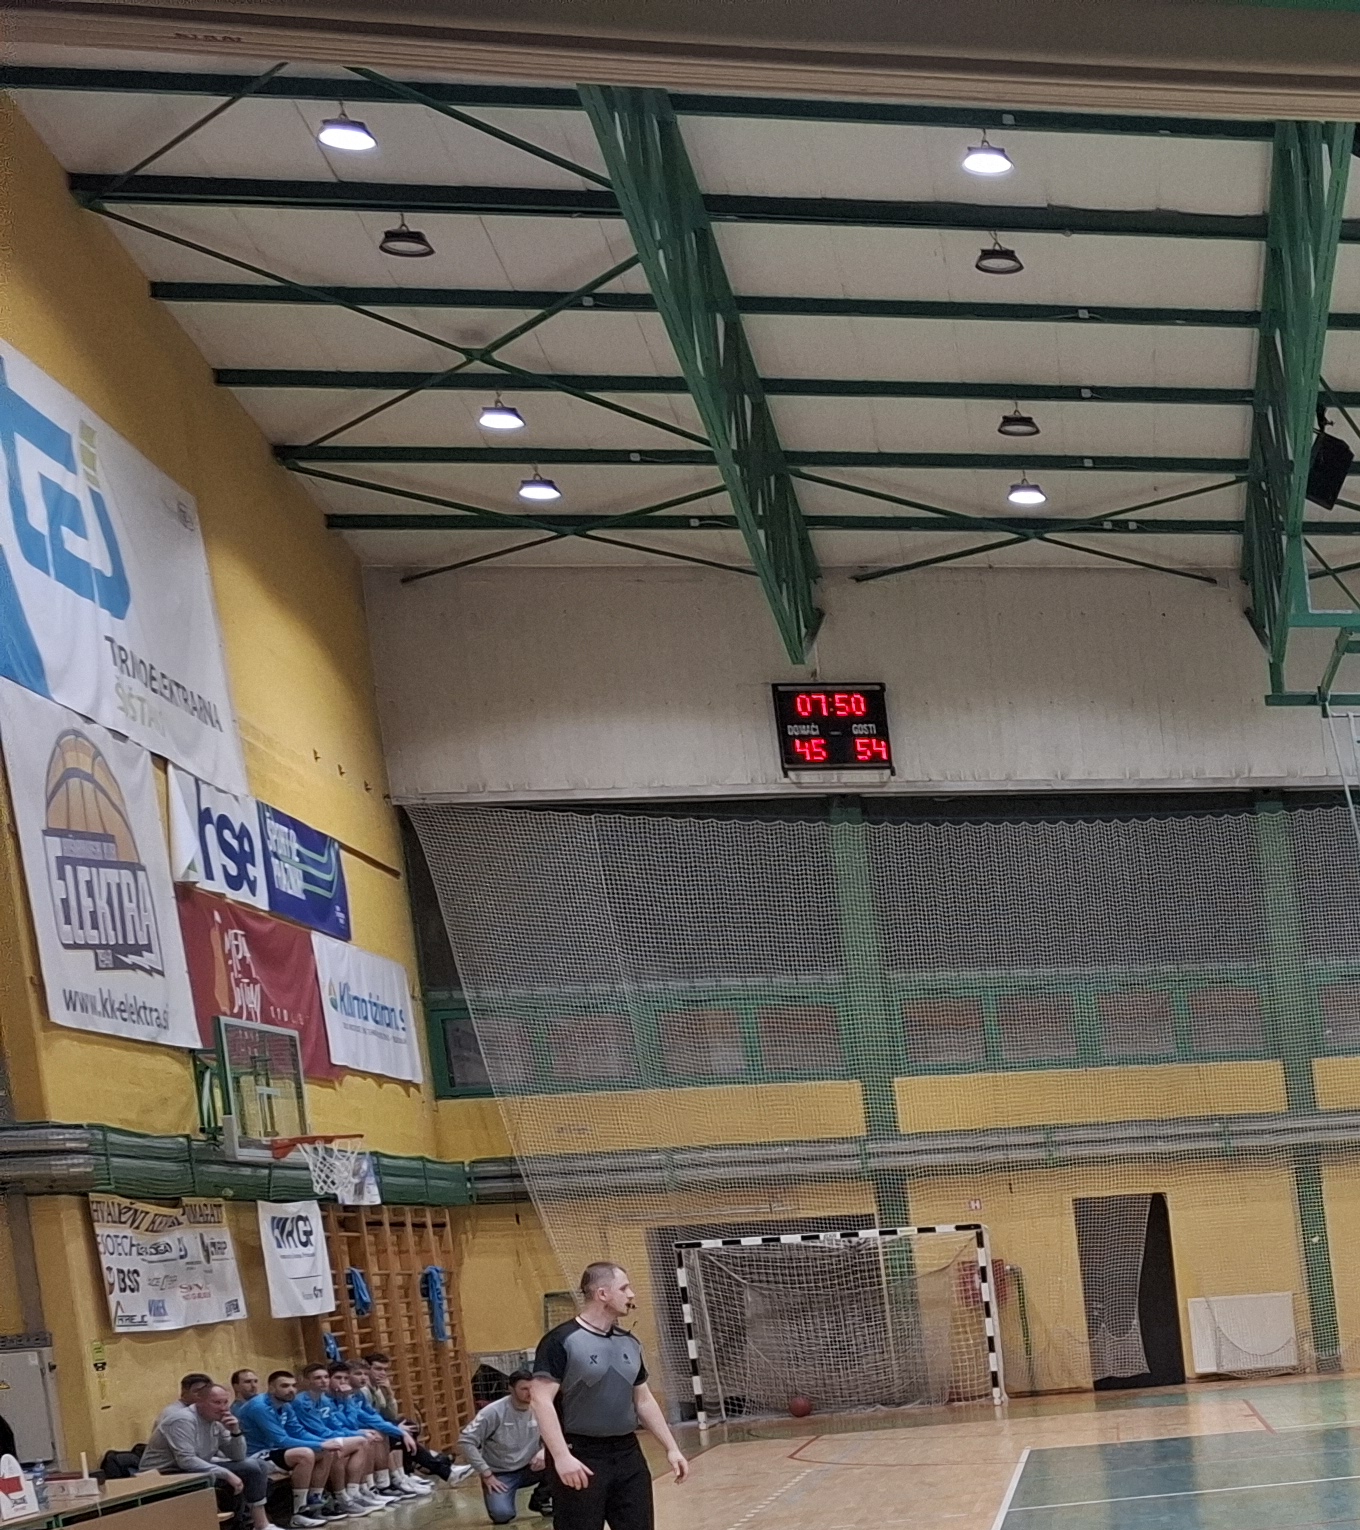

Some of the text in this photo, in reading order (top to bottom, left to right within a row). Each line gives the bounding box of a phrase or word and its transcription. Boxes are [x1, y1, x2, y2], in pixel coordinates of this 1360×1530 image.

[796, 693, 866, 716] 07:50
[851, 723, 877, 735] GOSTI
[795, 738, 889, 761] 45 54
[52, 863, 151, 946] ELEKTRA
